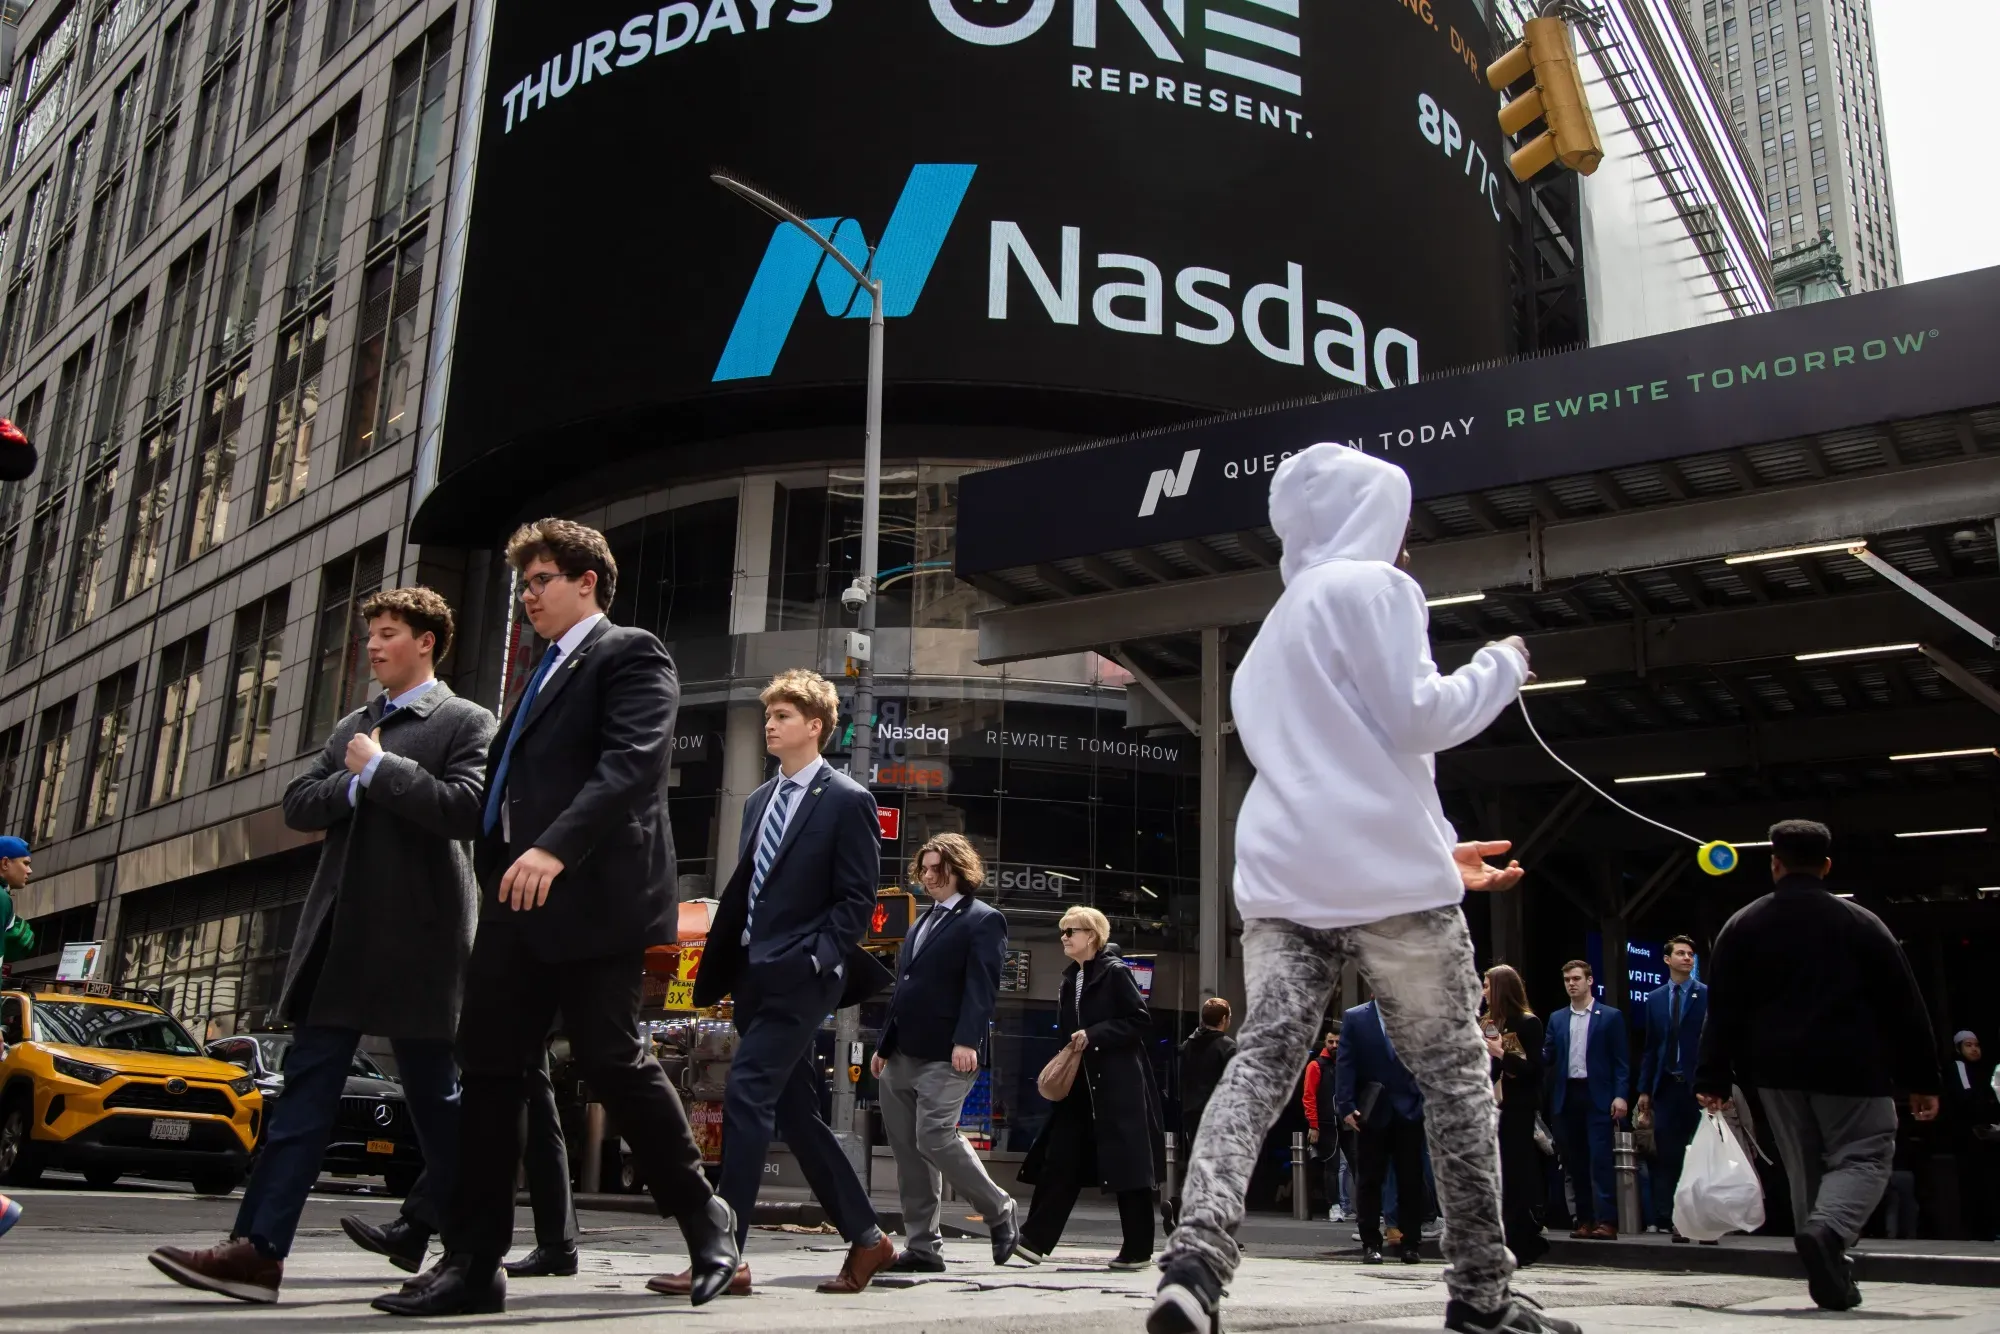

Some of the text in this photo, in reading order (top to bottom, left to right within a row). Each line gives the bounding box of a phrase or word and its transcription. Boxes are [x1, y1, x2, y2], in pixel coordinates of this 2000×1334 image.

[1072, 64, 1313, 139] REPRESENT.
[1379, 417, 1475, 450] TODAY
[1506, 380, 1669, 427] REWRITE
[878, 723, 949, 745] Nasdaq
[986, 730, 1069, 750] REWRITE
[1077, 737, 1179, 762] TOMORROW
[1630, 946, 1651, 958] Nasdaq
